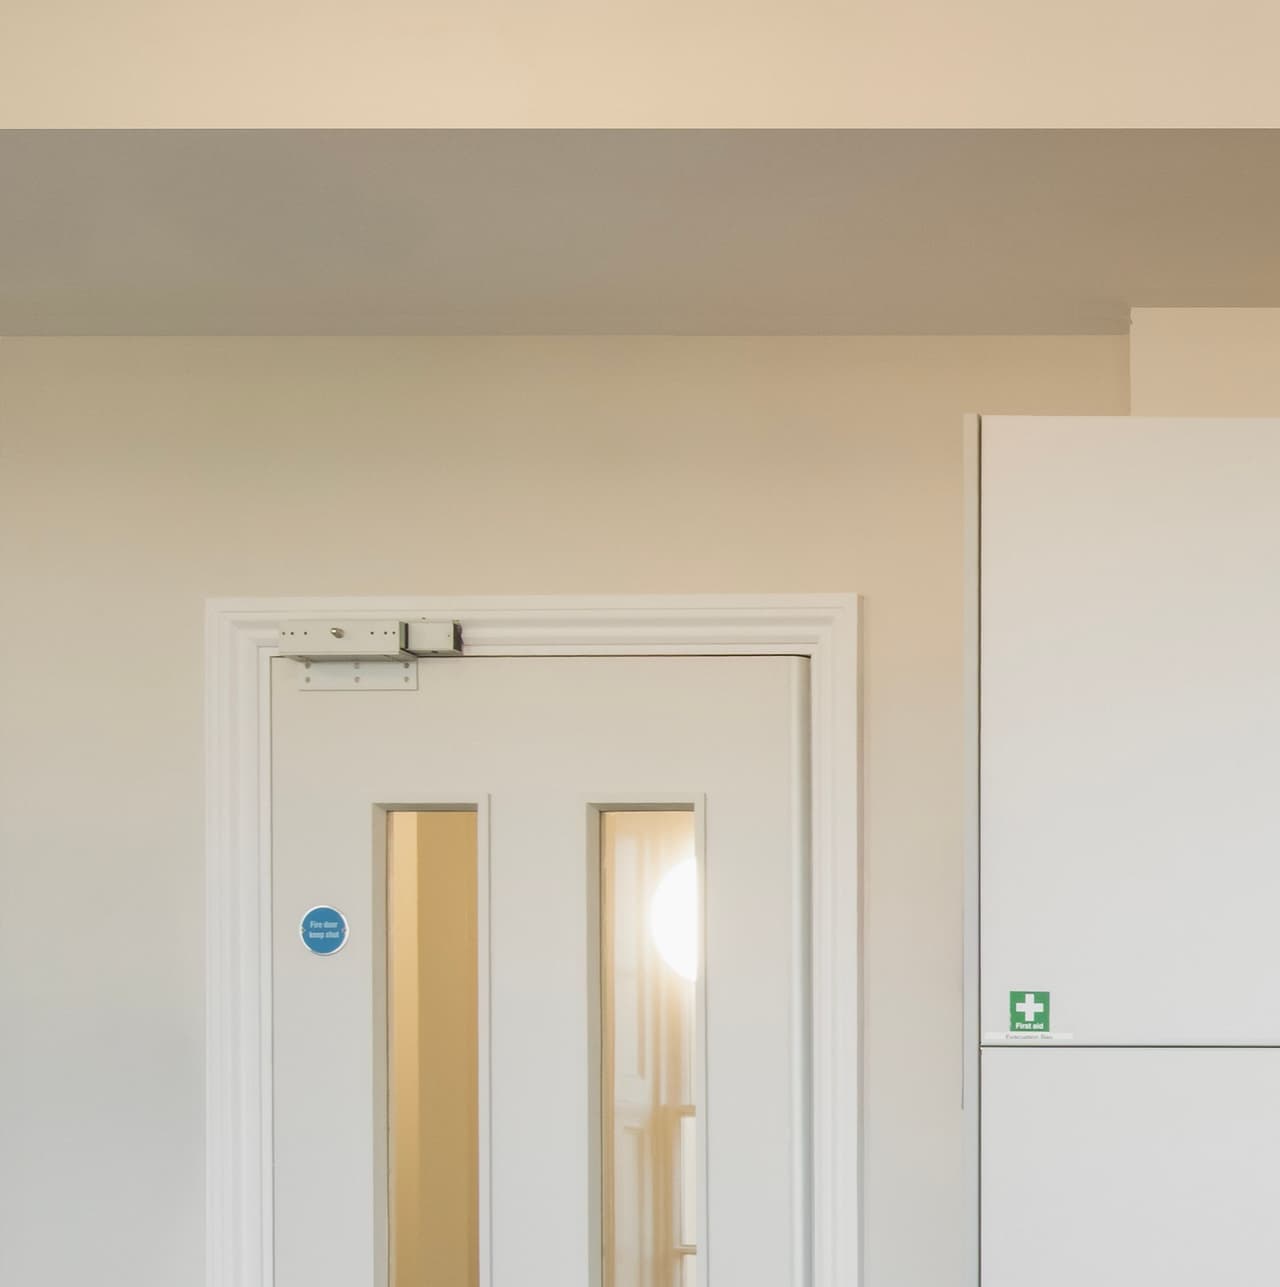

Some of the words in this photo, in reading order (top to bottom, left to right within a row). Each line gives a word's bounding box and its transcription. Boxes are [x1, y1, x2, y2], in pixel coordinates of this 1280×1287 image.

[310, 920, 322, 928] Fire
[1015, 1022, 1032, 1030] First
[1032, 1022, 1044, 1030] aid
